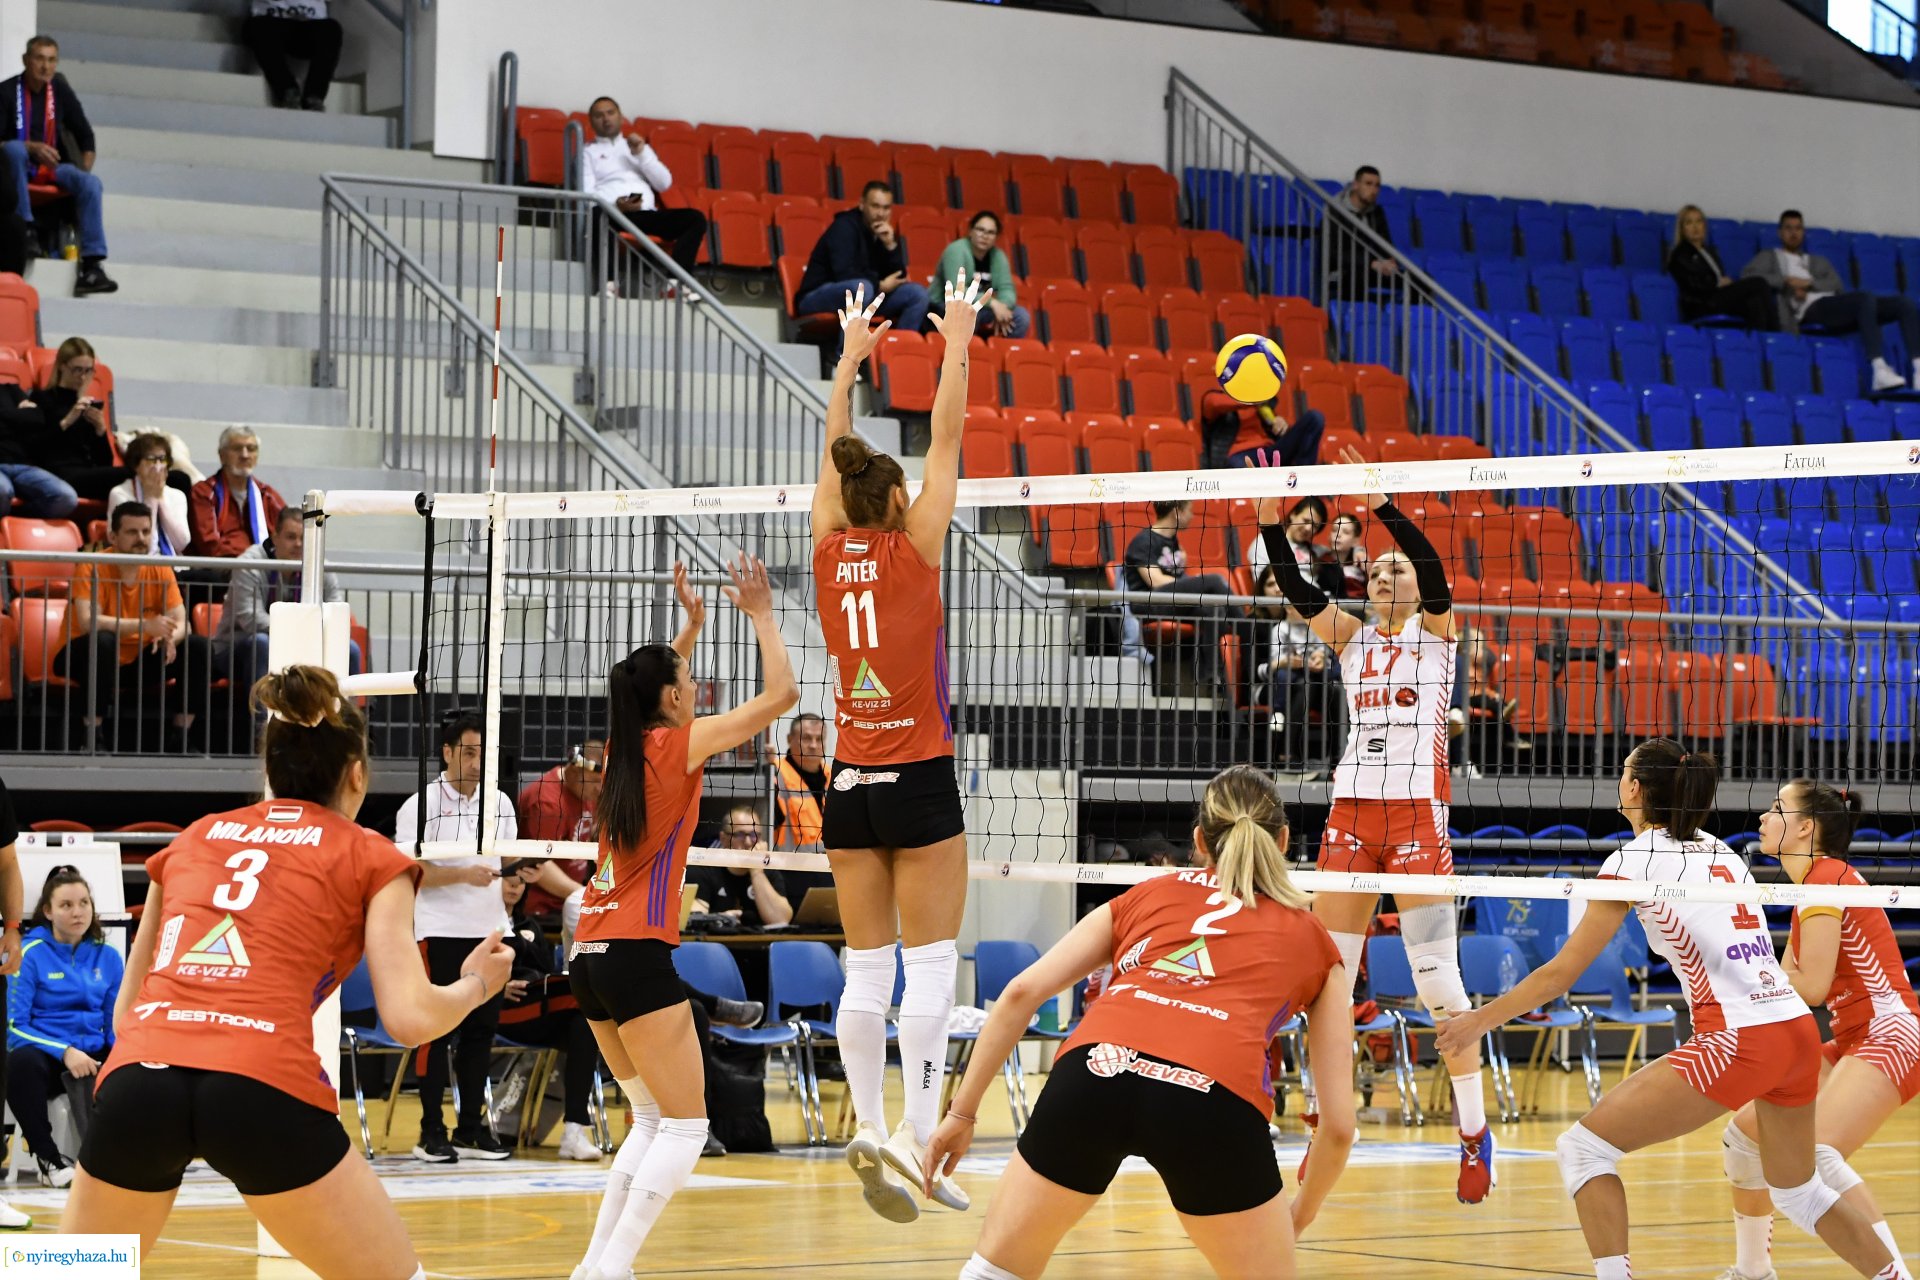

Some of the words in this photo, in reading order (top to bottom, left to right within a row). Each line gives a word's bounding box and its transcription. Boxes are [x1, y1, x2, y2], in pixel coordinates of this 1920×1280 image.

[841, 590, 879, 649] 11
[1360, 644, 1402, 679] 17
[852, 699, 879, 709] KE-VIZ
[880, 699, 891, 708] 21
[852, 717, 915, 730] BESTRONG
[205, 820, 323, 847] MILANOVA
[212, 848, 269, 911] 3
[1190, 892, 1244, 935] 2
[176, 964, 227, 978] KE-VIZ
[229, 967, 249, 978] 21
[1134, 989, 1229, 1021] BESTRONG
[166, 1009, 276, 1034] BESTRONG
[922, 1060, 936, 1090] MIKASA
[1132, 1060, 1214, 1091] REVESZ
